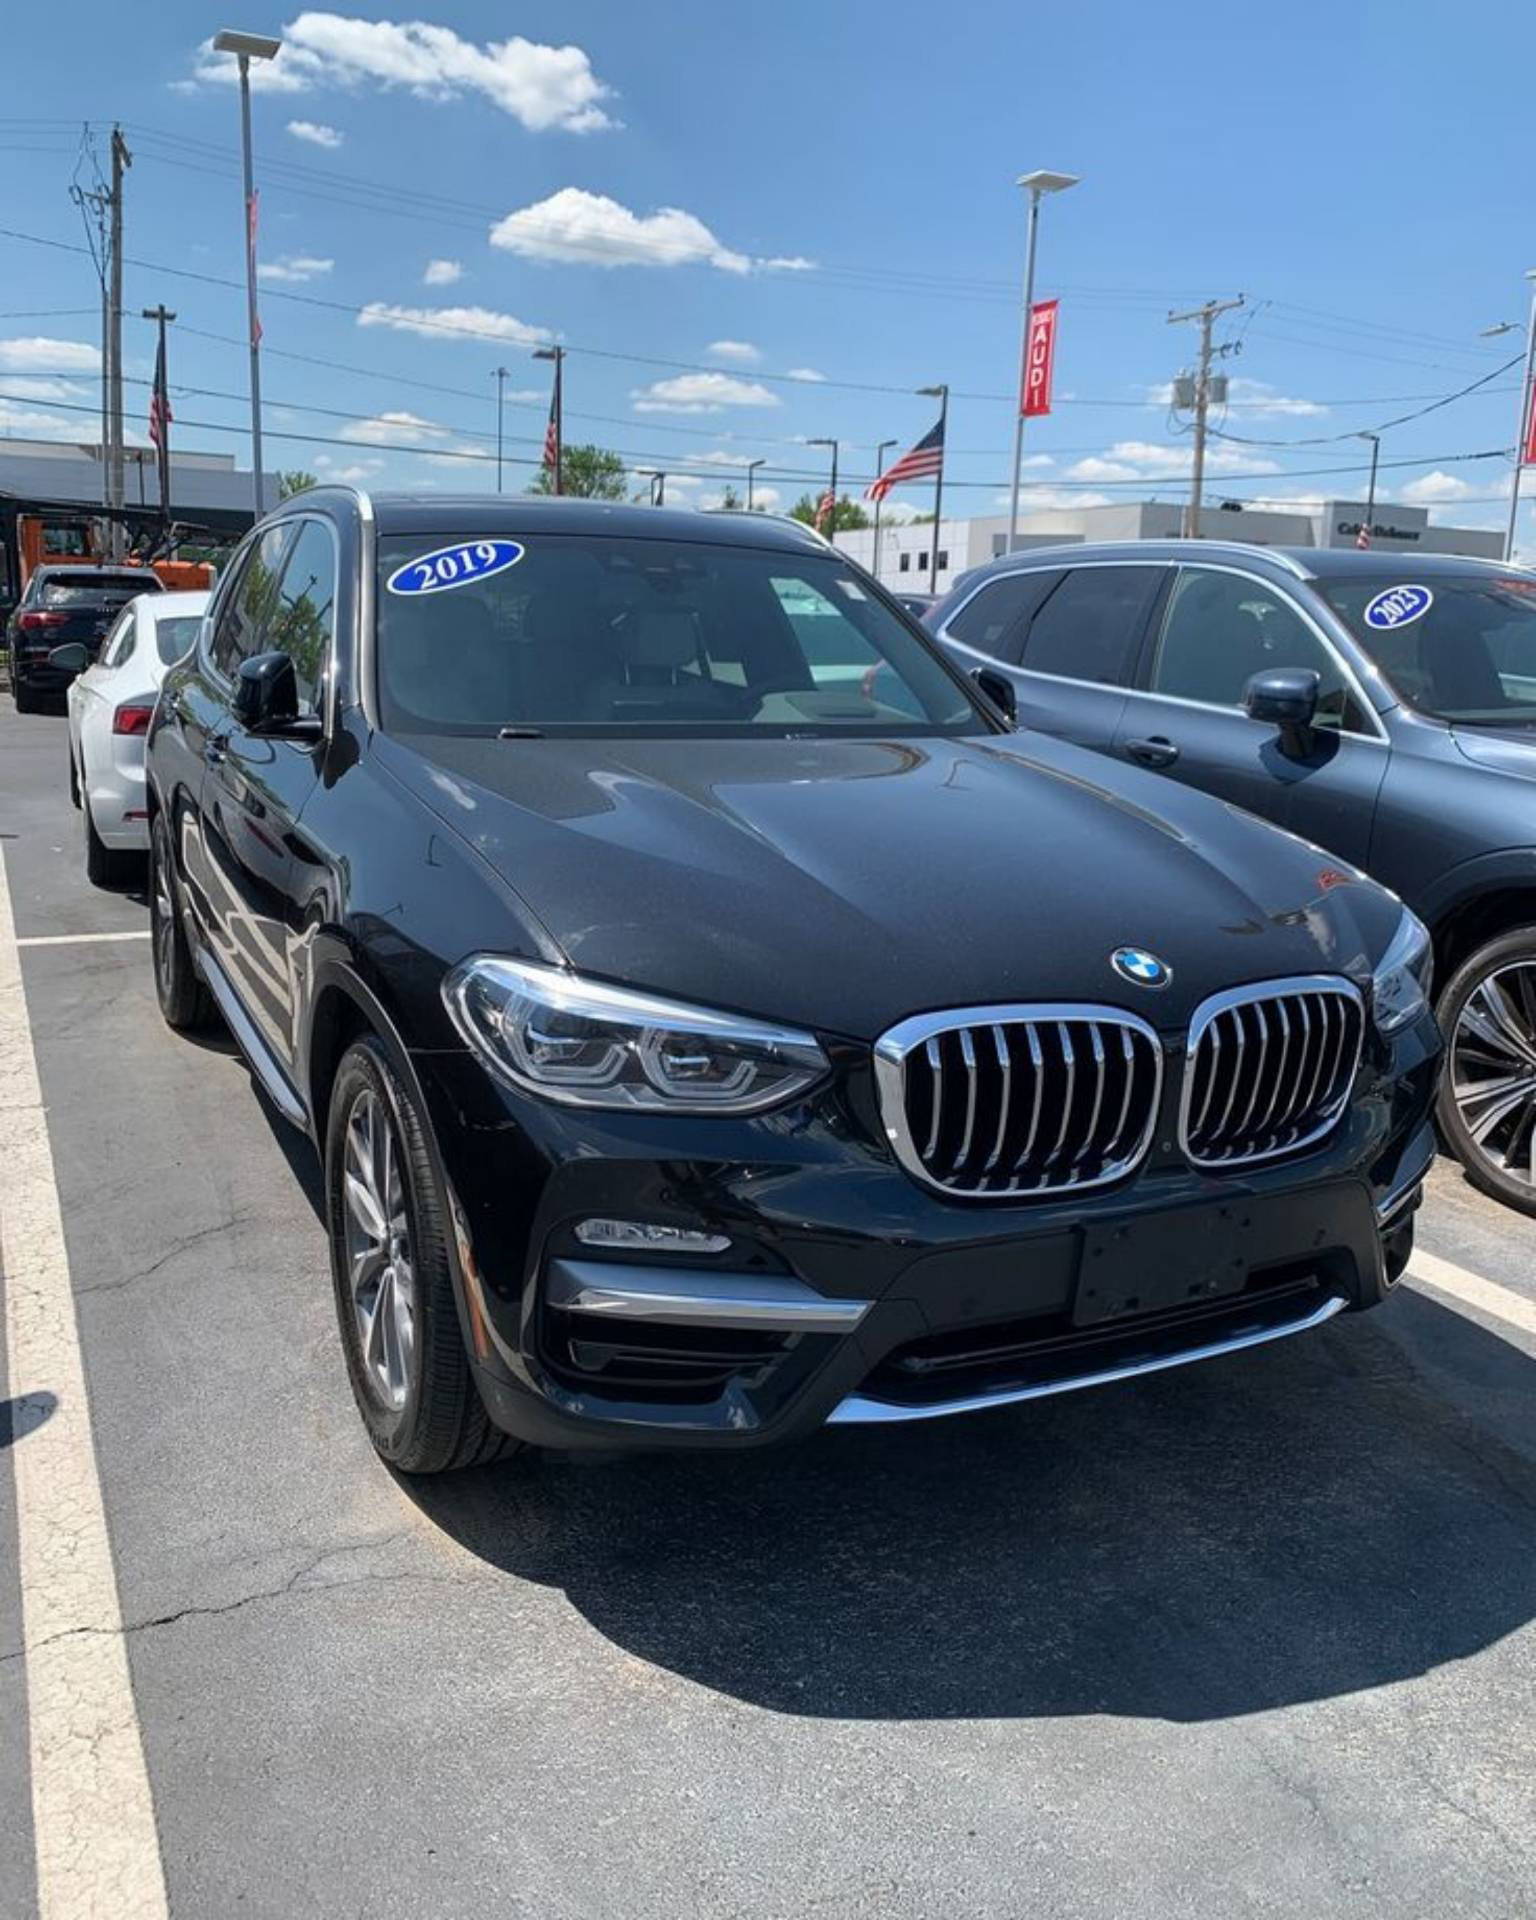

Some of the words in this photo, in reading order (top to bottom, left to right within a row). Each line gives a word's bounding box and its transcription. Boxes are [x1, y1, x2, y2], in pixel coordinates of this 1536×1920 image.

[1030, 324, 1047, 408] AUDI
[414, 543, 497, 590] 2019
[1373, 589, 1420, 625] 2023
